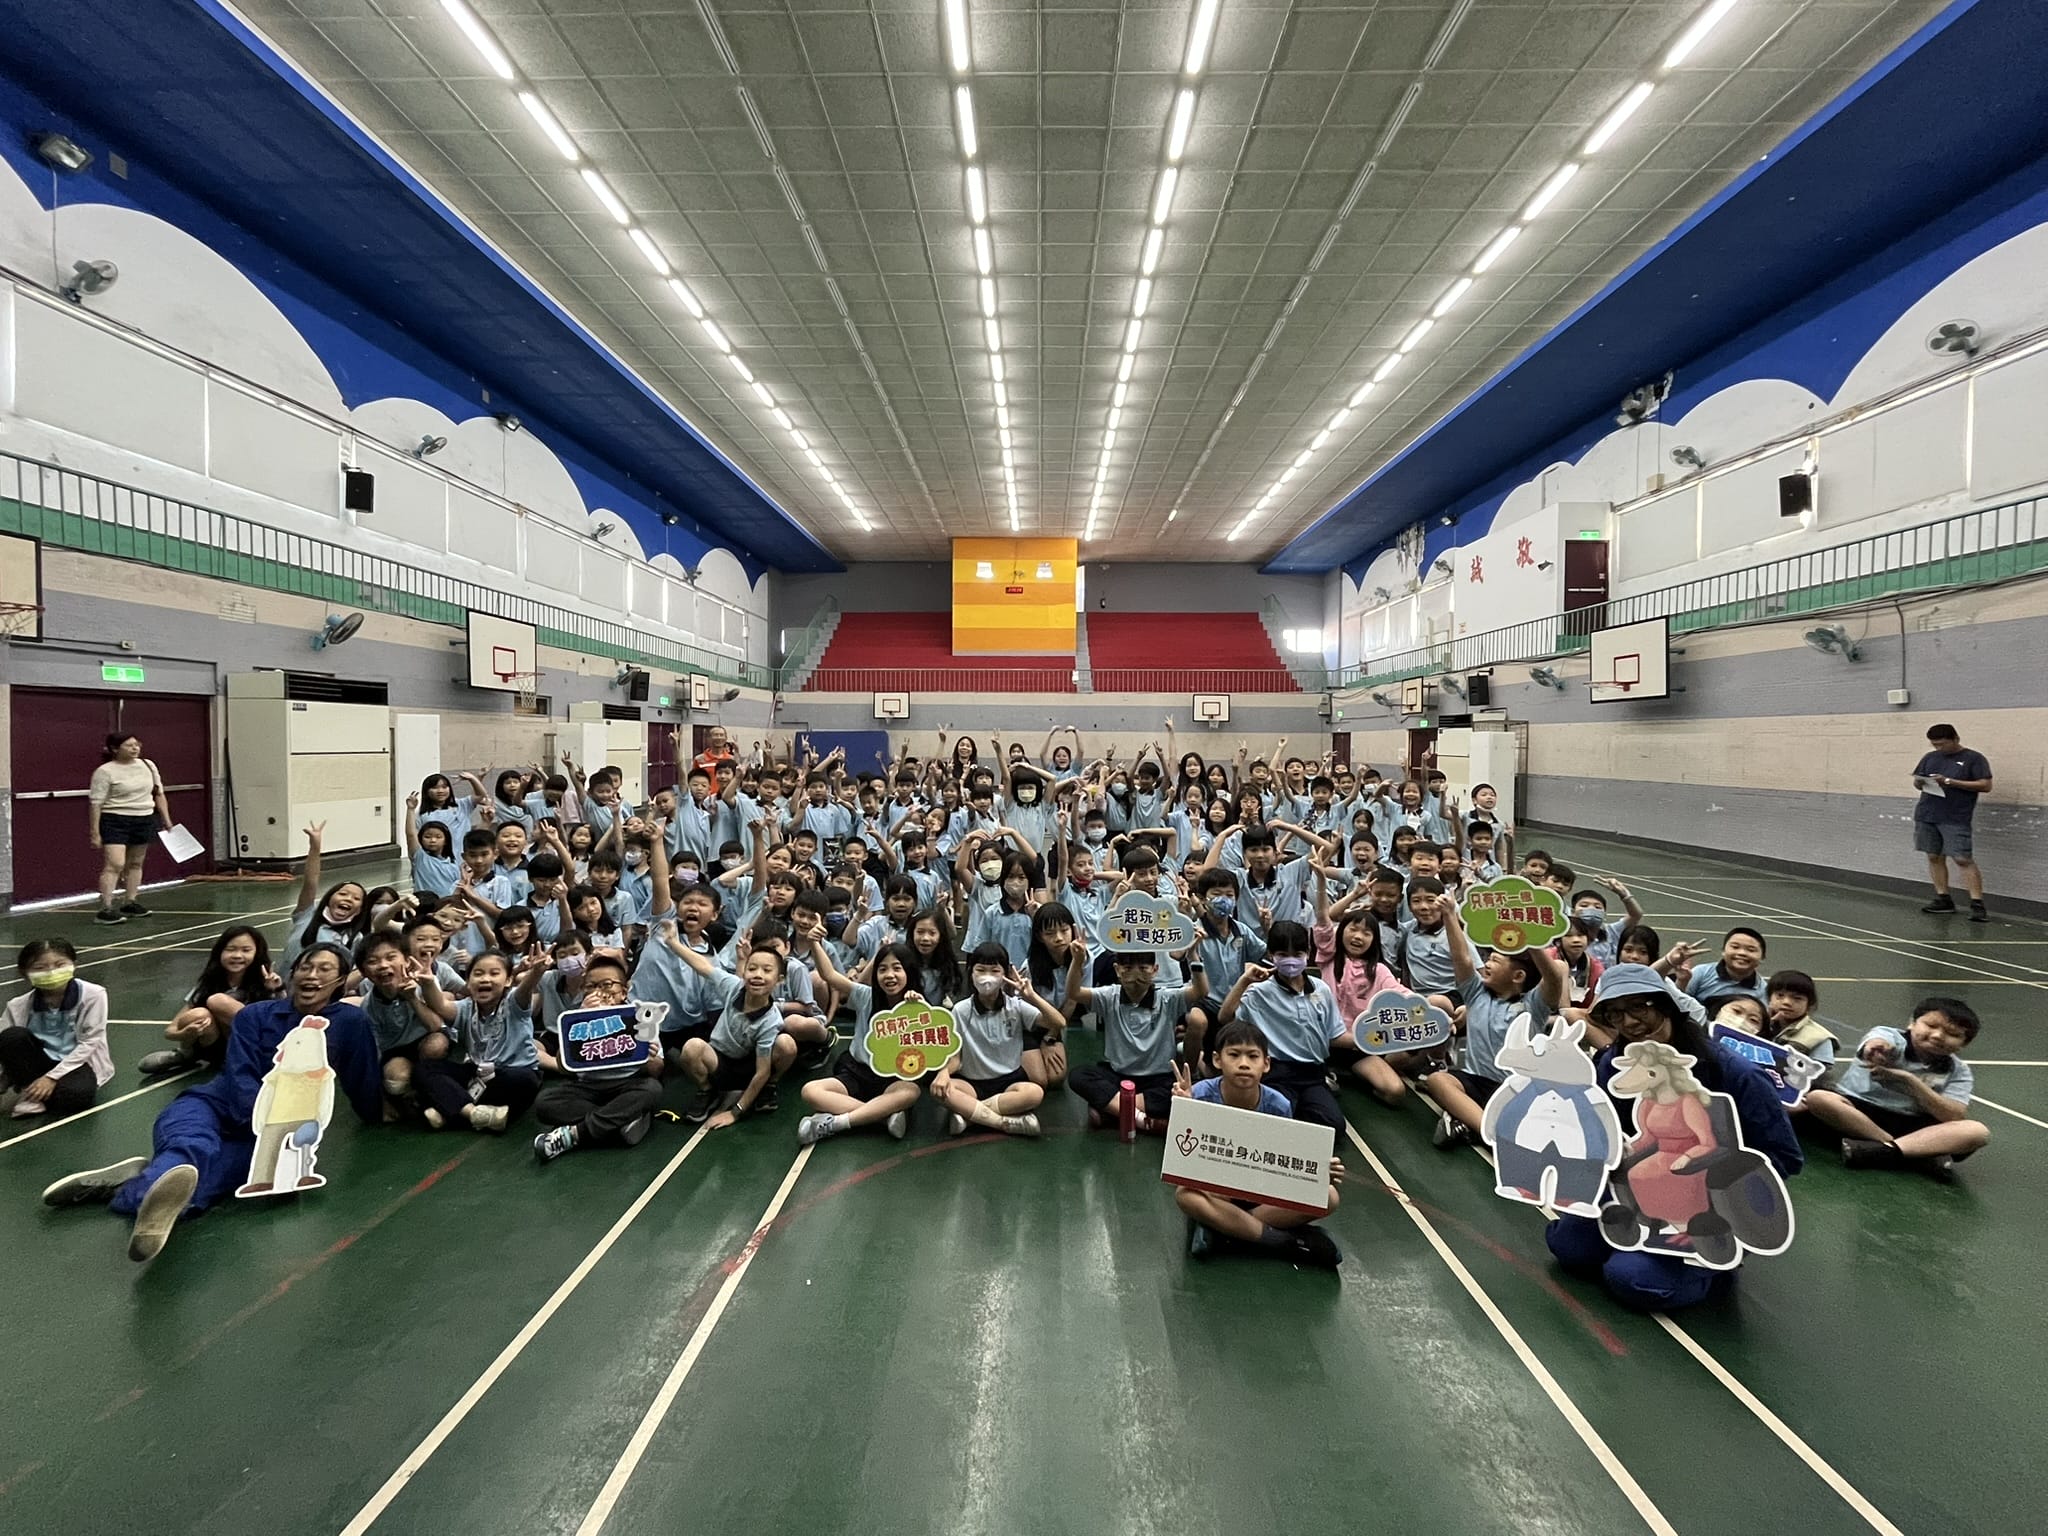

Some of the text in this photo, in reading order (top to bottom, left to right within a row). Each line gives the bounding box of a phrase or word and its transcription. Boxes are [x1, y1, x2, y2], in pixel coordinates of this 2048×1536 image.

[1109, 908, 1153, 924] 一起玩
[1364, 1008, 1408, 1025] 一起玩
[1200, 1133, 1235, 1148] 社團法人
[1199, 1144, 1234, 1159] 中華民國
[1235, 1146, 1319, 1175] 身心障礙聯盟
